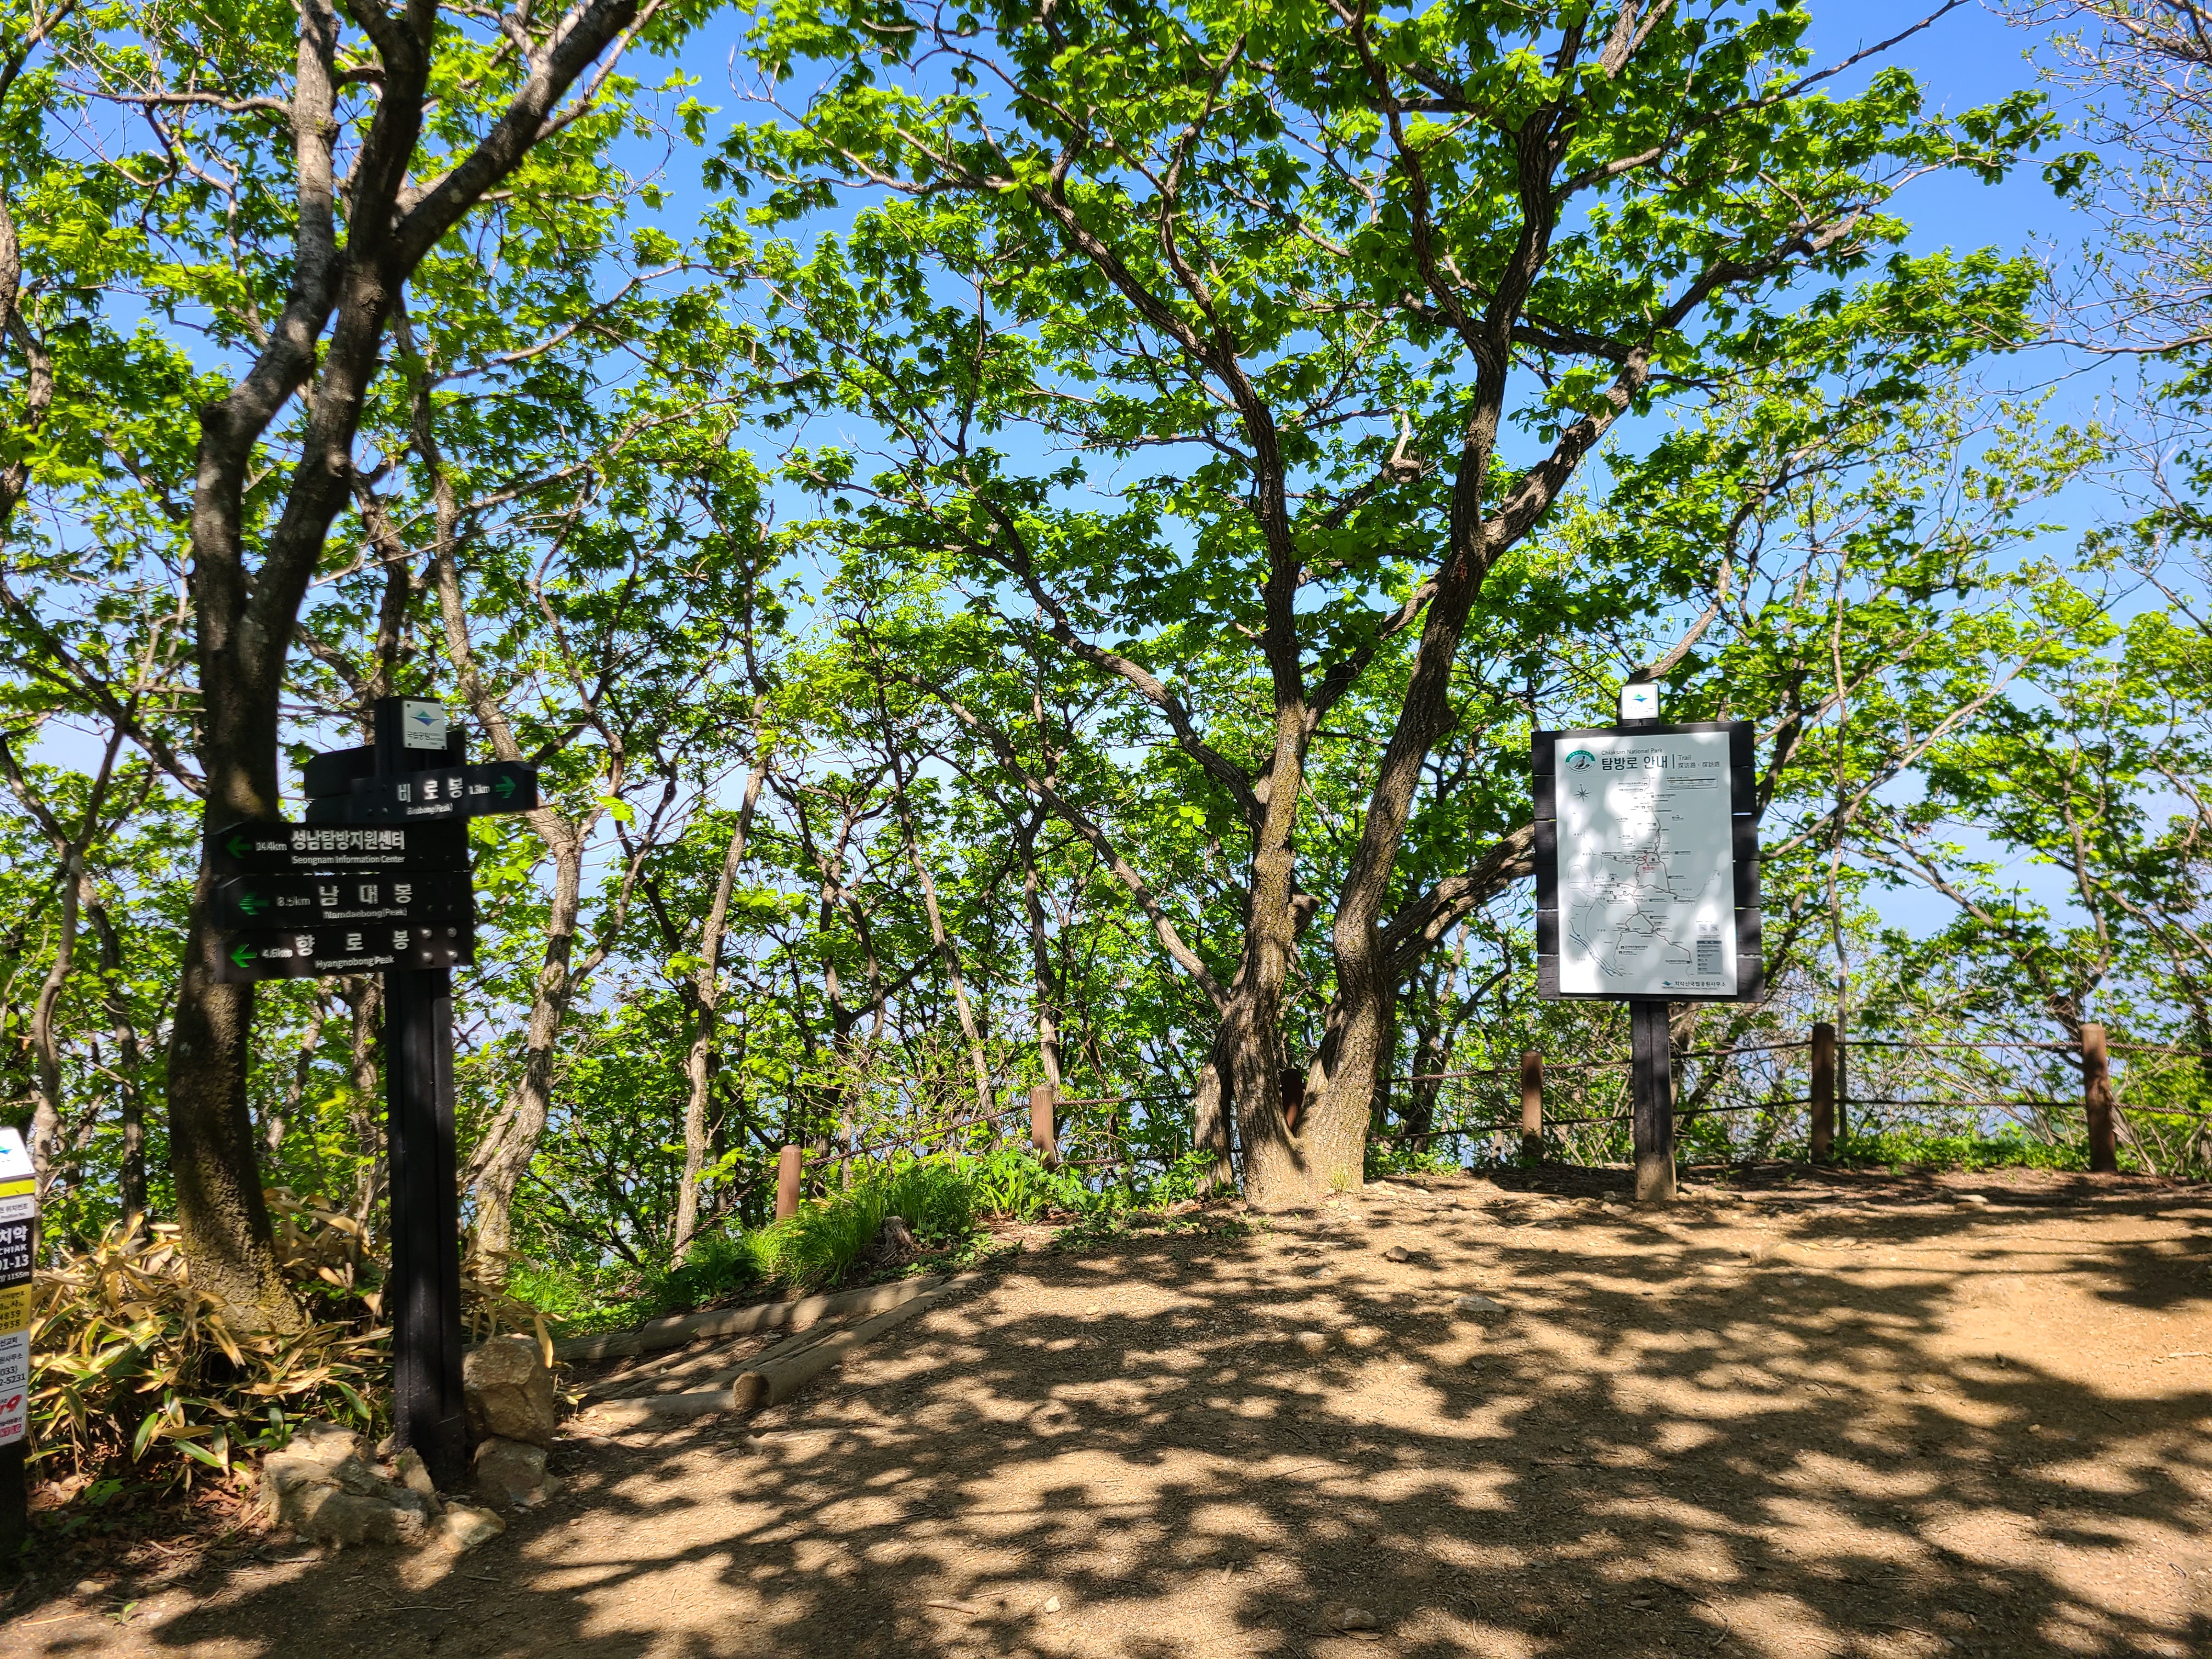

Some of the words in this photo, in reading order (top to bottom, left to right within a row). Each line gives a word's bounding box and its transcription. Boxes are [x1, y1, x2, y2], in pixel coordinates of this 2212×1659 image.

[1601, 757, 1641, 771] 탐방로
[1643, 755, 1668, 769] 안내
[291, 829, 405, 851] 성남탐방지원센터
[292, 855, 334, 866] Seongnam
[336, 855, 380, 864] Information
[381, 855, 405, 864] Center
